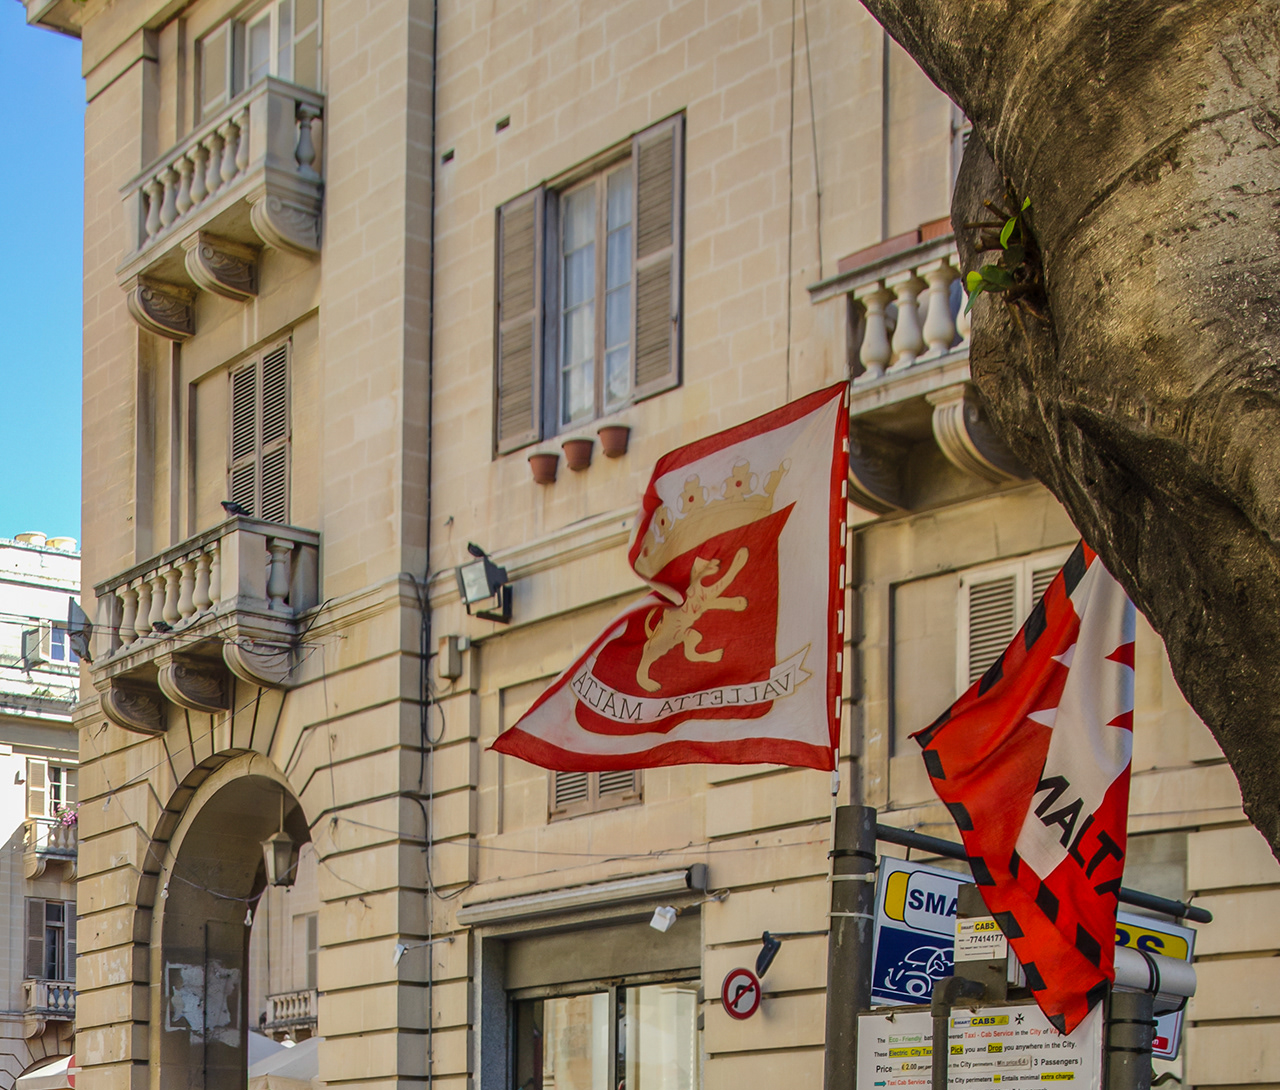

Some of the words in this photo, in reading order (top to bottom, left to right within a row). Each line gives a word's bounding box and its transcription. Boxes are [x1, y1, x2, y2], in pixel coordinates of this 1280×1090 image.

[908, 889, 958, 917] SMA
[975, 922, 994, 930] CABS
[970, 934, 1003, 943] 77414177
[972, 1018, 995, 1026] CABS
[1030, 1028, 1042, 1036] City
[988, 1044, 1002, 1054] Drop
[1016, 1042, 1043, 1052] anywhere
[960, 1061, 971, 1069] City
[1040, 1058, 1078, 1066] Passengers
[966, 1076, 992, 1084] perimeters
